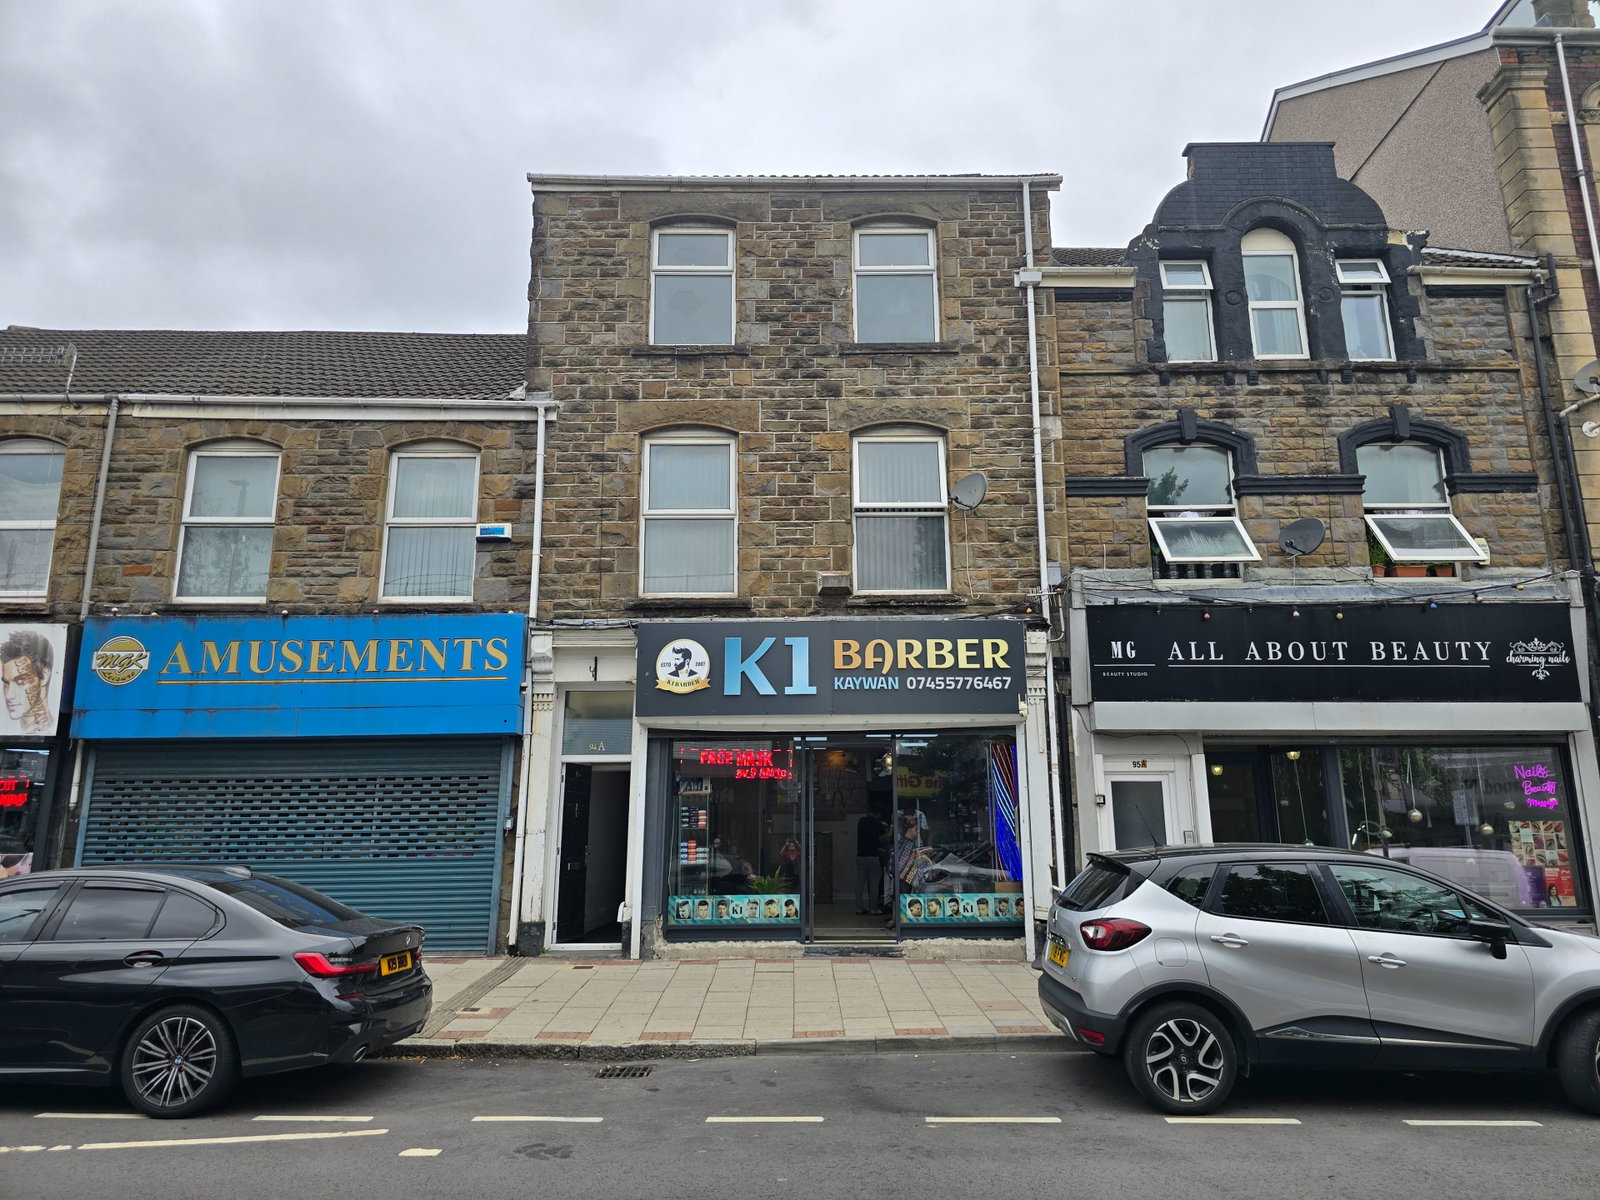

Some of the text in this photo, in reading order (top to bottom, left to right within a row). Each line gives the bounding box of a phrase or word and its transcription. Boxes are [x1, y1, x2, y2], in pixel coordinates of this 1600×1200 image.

[159, 637, 508, 675] AMUSEMENTS
[833, 638, 1012, 675] BARBER
[1111, 641, 1136, 659] MG
[1167, 641, 1492, 661] ALL ABOUT BEAUTY
[1506, 650, 1570, 669] charming nails
[95, 653, 148, 674] MGK
[723, 636, 818, 696] K1
[833, 676, 1012, 690] KAYWAN 07455776467
[700, 751, 774, 767] FACE MASK
[1513, 763, 1550, 779] Nails
[1522, 780, 1558, 795] Beauty
